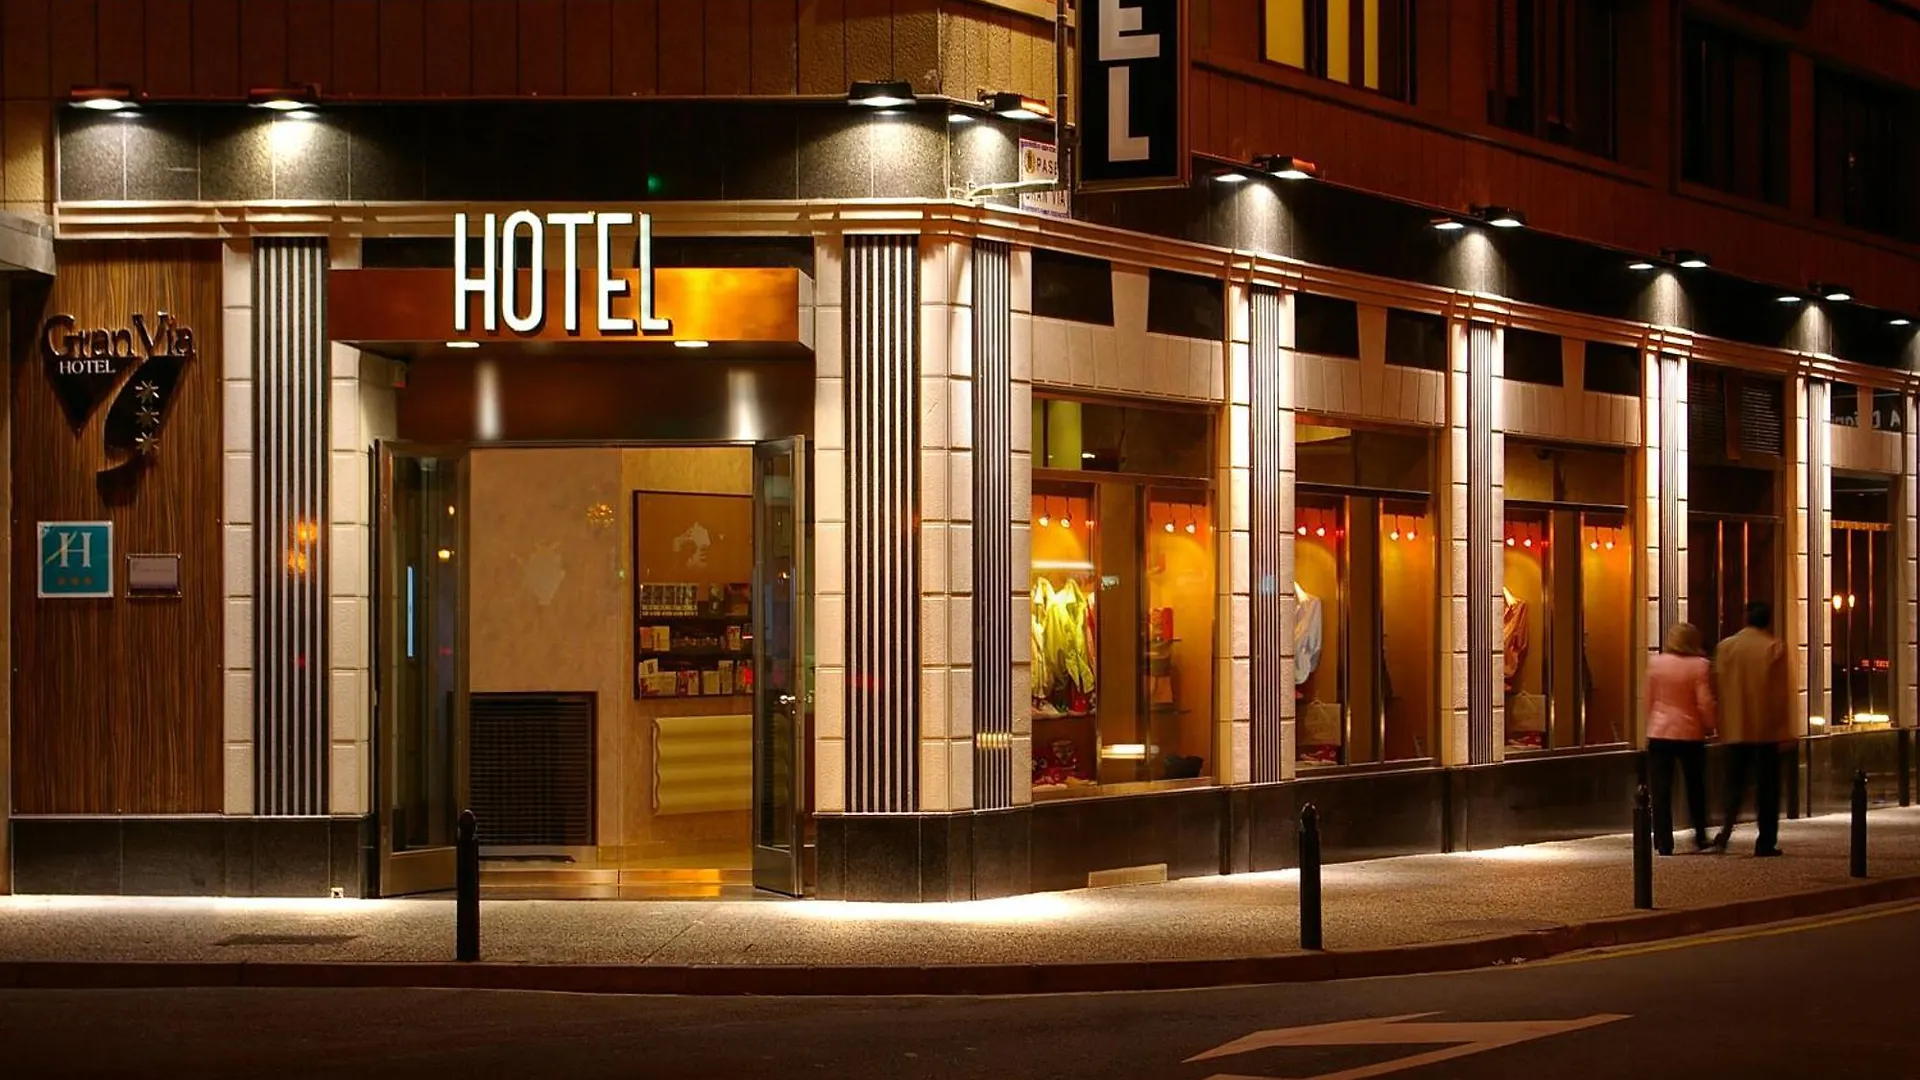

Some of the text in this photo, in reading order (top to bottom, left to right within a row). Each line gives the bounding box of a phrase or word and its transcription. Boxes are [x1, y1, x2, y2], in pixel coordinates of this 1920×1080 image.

[454, 210, 671, 332] HOTEL
[42, 314, 135, 358] Gran
[59, 359, 116, 374] HOTEL
[58, 531, 93, 568] H
